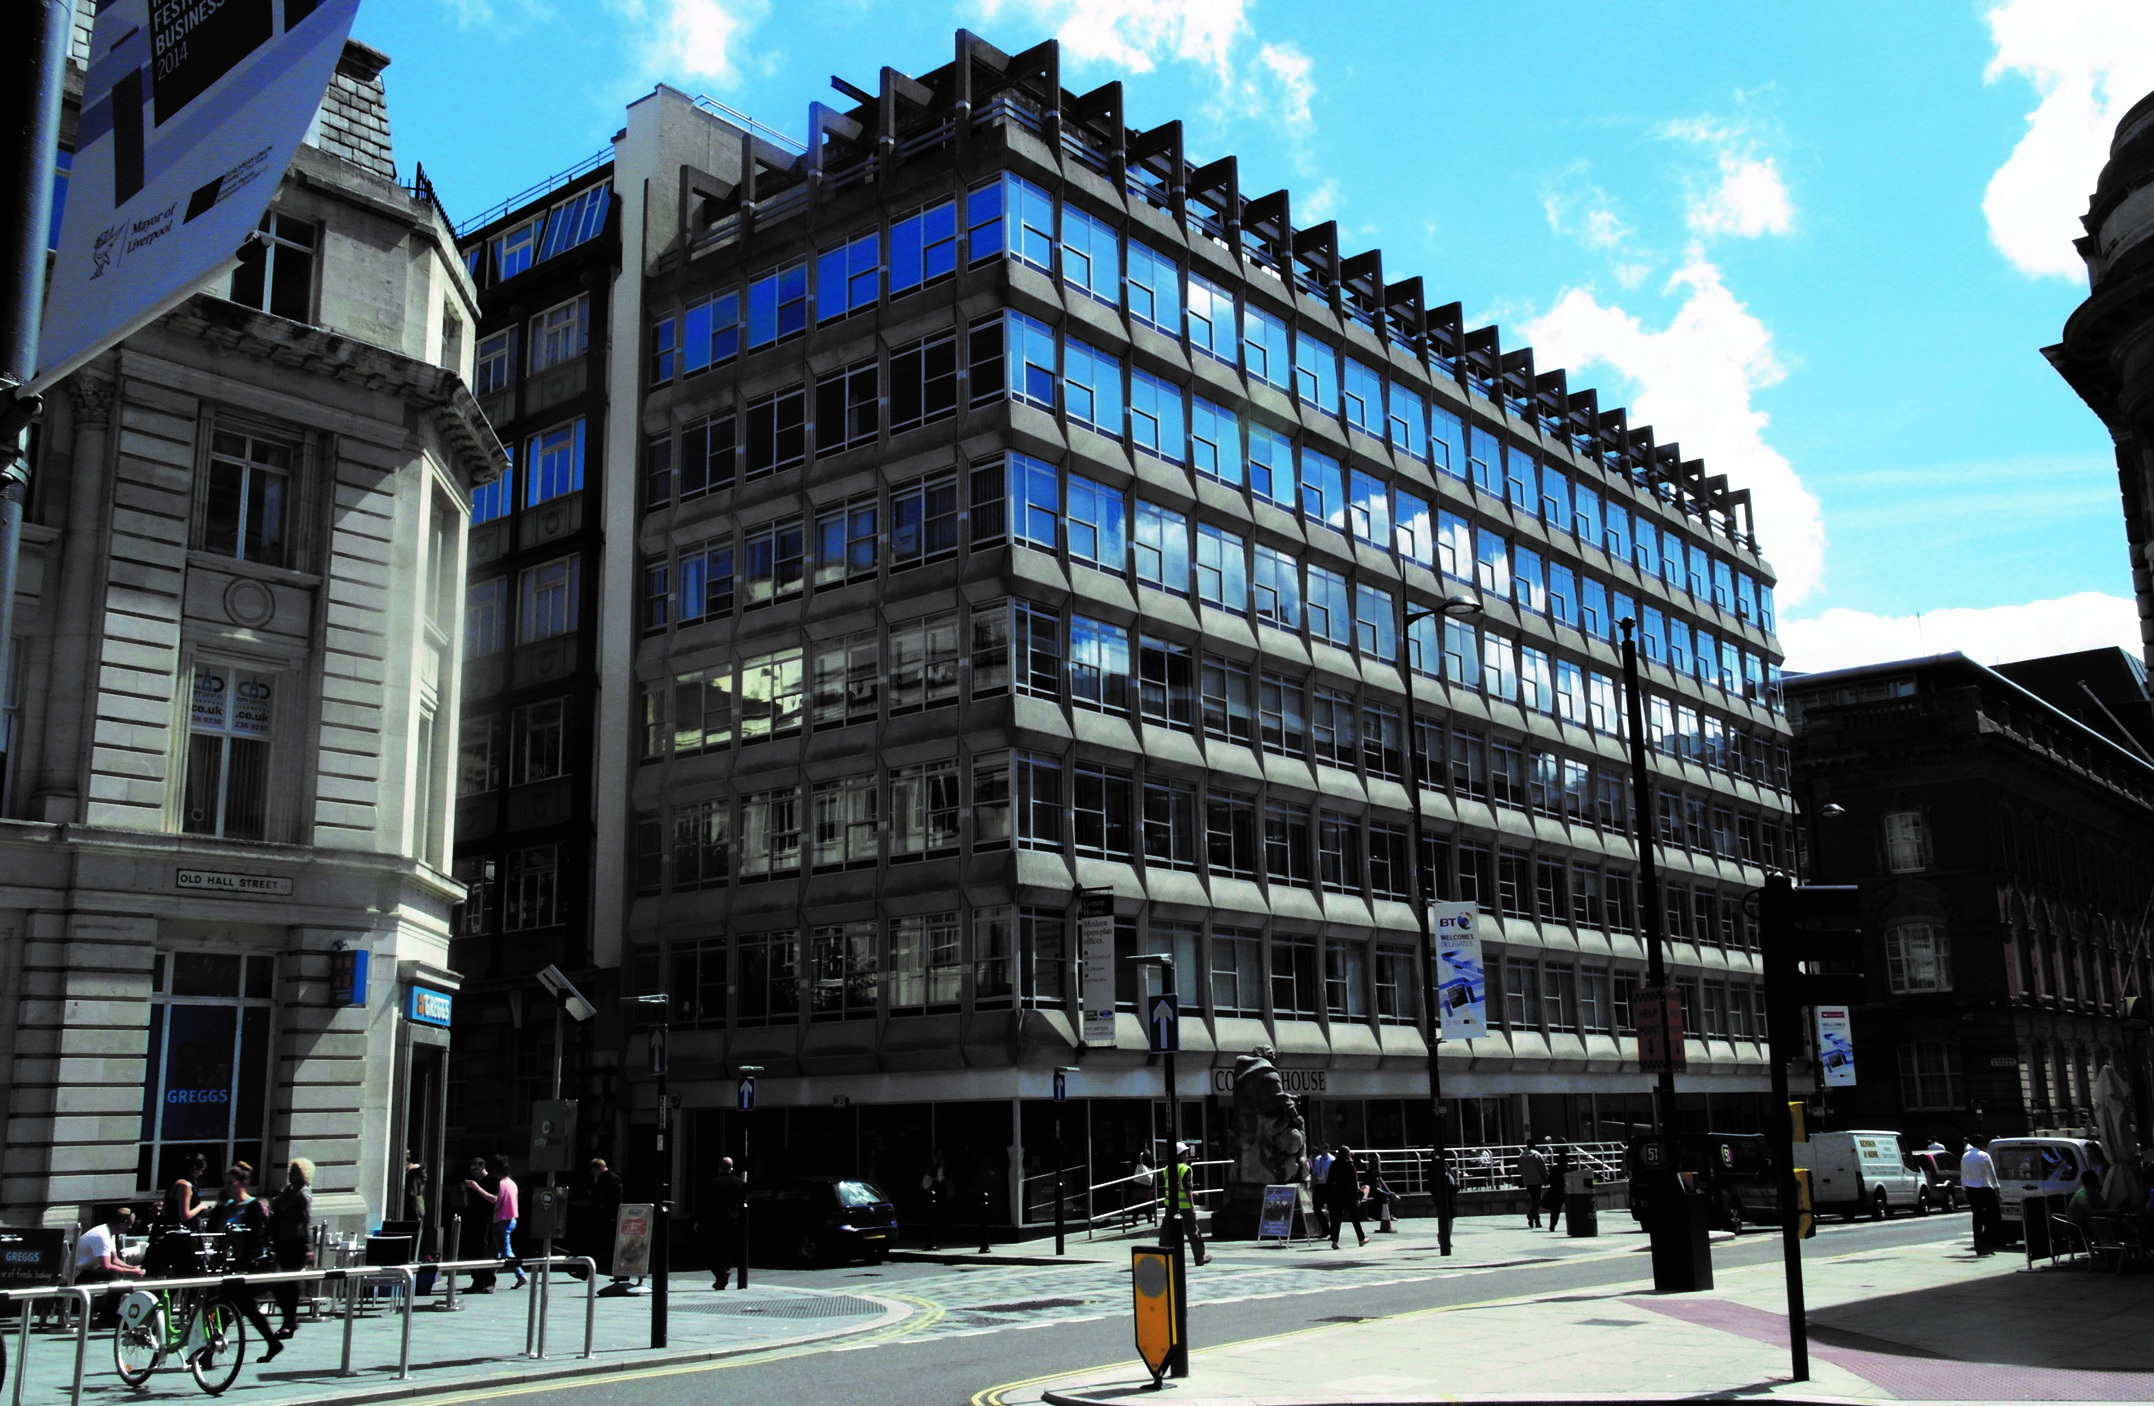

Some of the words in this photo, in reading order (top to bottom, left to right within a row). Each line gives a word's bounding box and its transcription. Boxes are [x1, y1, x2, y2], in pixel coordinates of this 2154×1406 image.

[157, 41, 188, 81] 2014
[131, 212, 163, 236] Mayor
[163, 202, 178, 219] of
[126, 220, 173, 254] Liverpool
[180, 874, 202, 884] OLD
[207, 876, 234, 886] HALL
[239, 879, 278, 889] STREET
[1439, 918, 1456, 927] BT
[1639, 1008, 1658, 1018] HELP
[1639, 1025, 1661, 1035] POINT
[1281, 1071, 1326, 1092] HOUSE
[166, 1089, 228, 1104] GREGGS
[1647, 1147, 1659, 1161] 51
[5, 1251, 40, 1262] GREGGS
